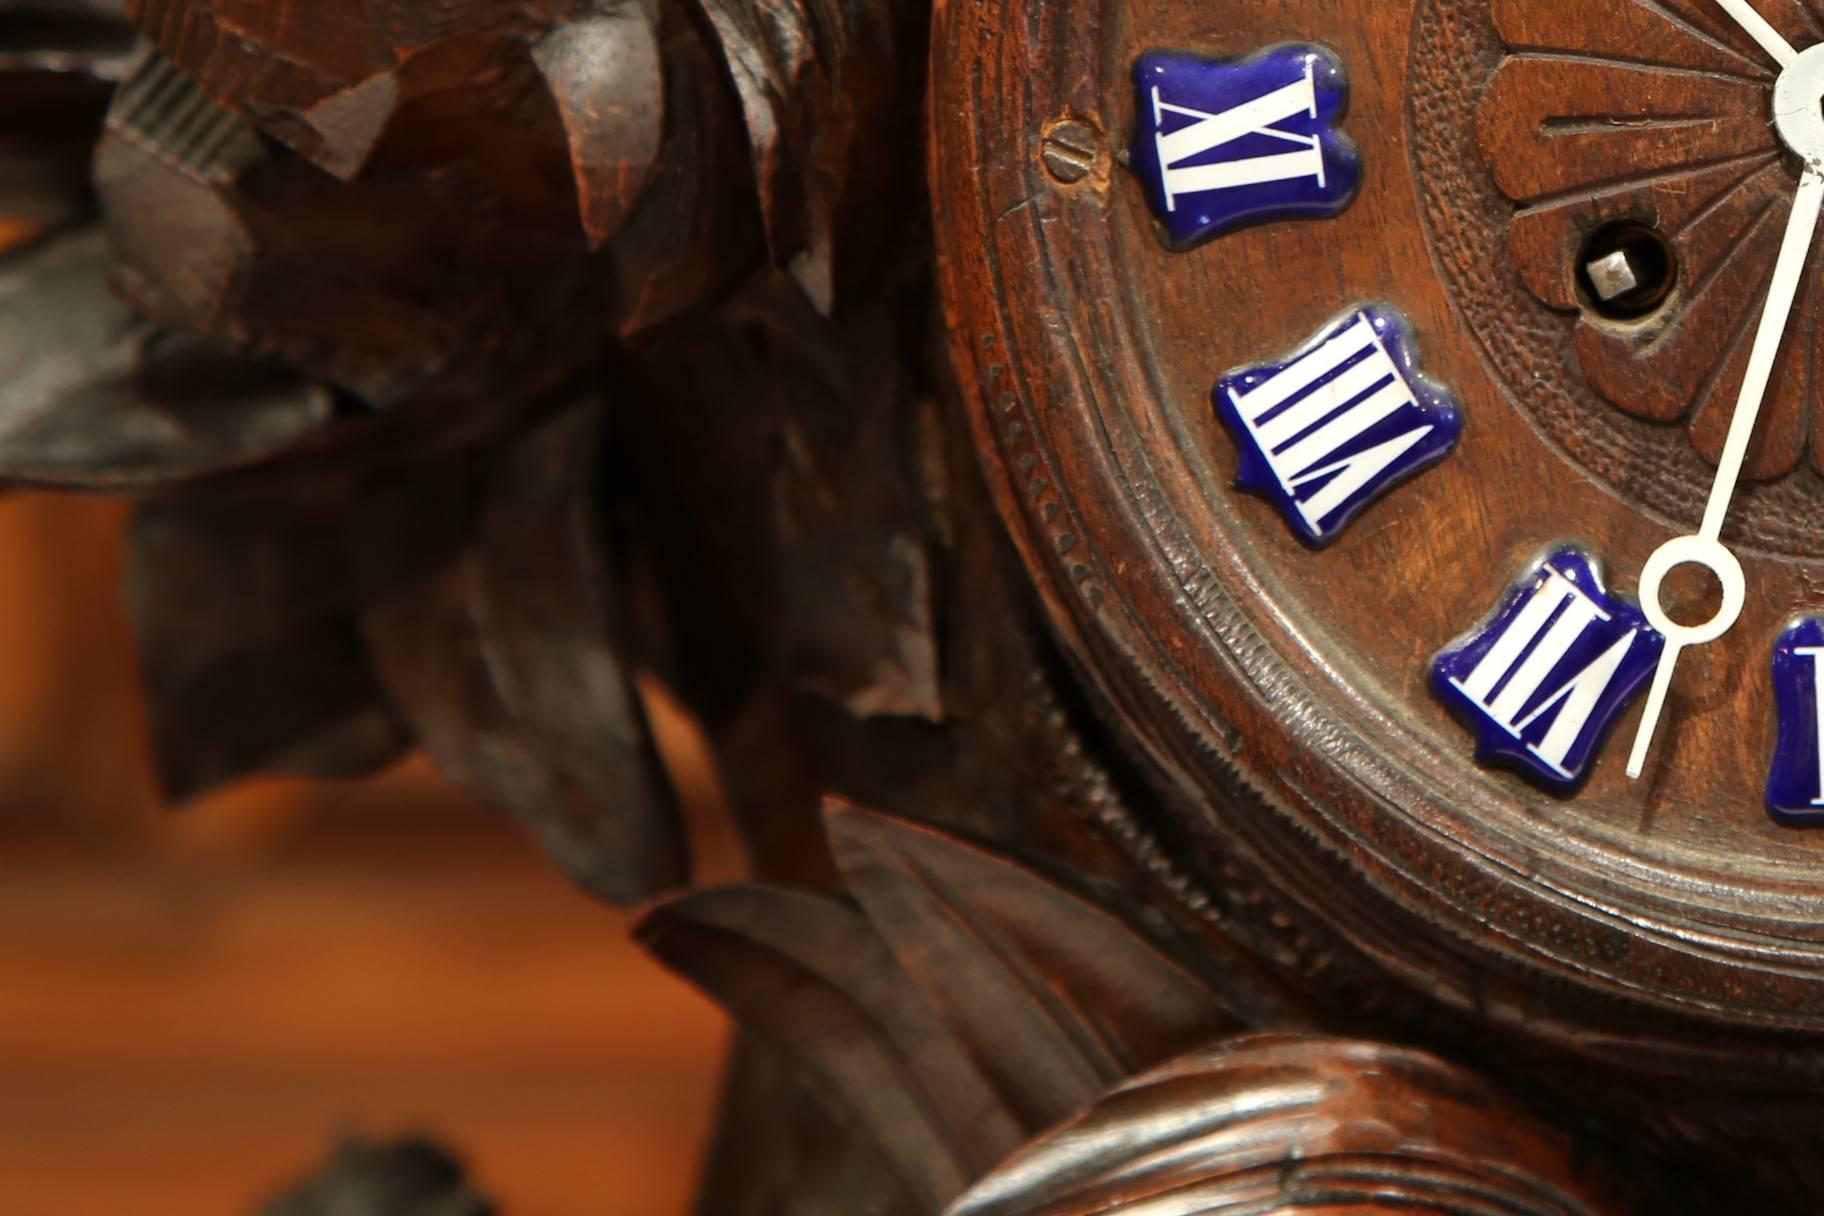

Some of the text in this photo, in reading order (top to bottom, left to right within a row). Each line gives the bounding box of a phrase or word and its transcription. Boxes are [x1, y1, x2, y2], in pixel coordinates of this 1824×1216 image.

[1152, 54, 1325, 211] IX
[1228, 315, 1433, 536] VIII
[1449, 563, 1637, 778] VII
